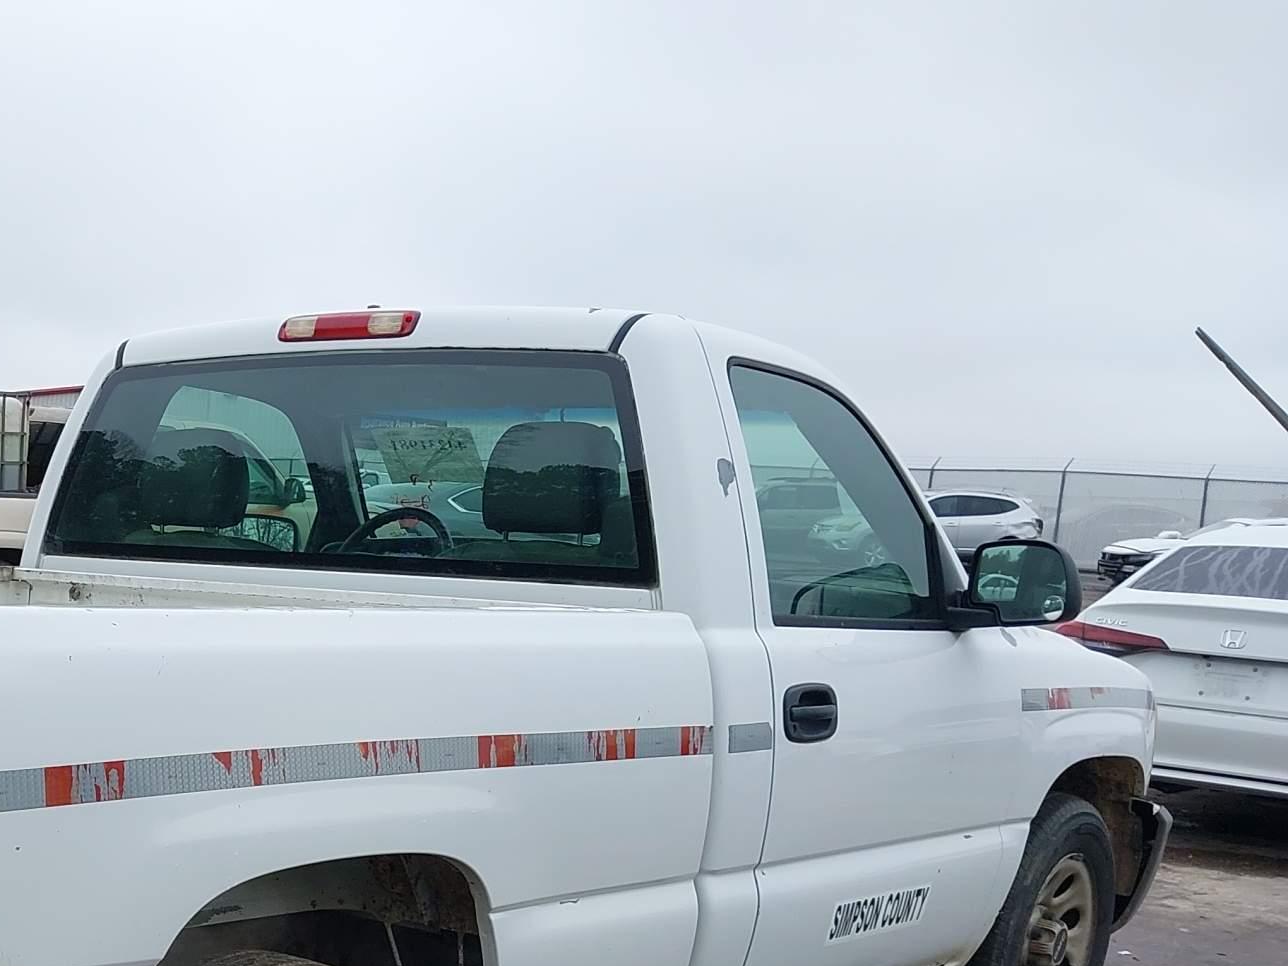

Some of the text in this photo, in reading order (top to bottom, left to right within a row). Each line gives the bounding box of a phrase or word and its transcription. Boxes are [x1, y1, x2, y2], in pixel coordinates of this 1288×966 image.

[1095, 616, 1128, 627] CIVIC
[829, 887, 930, 940] SIMPSON COUNTY
